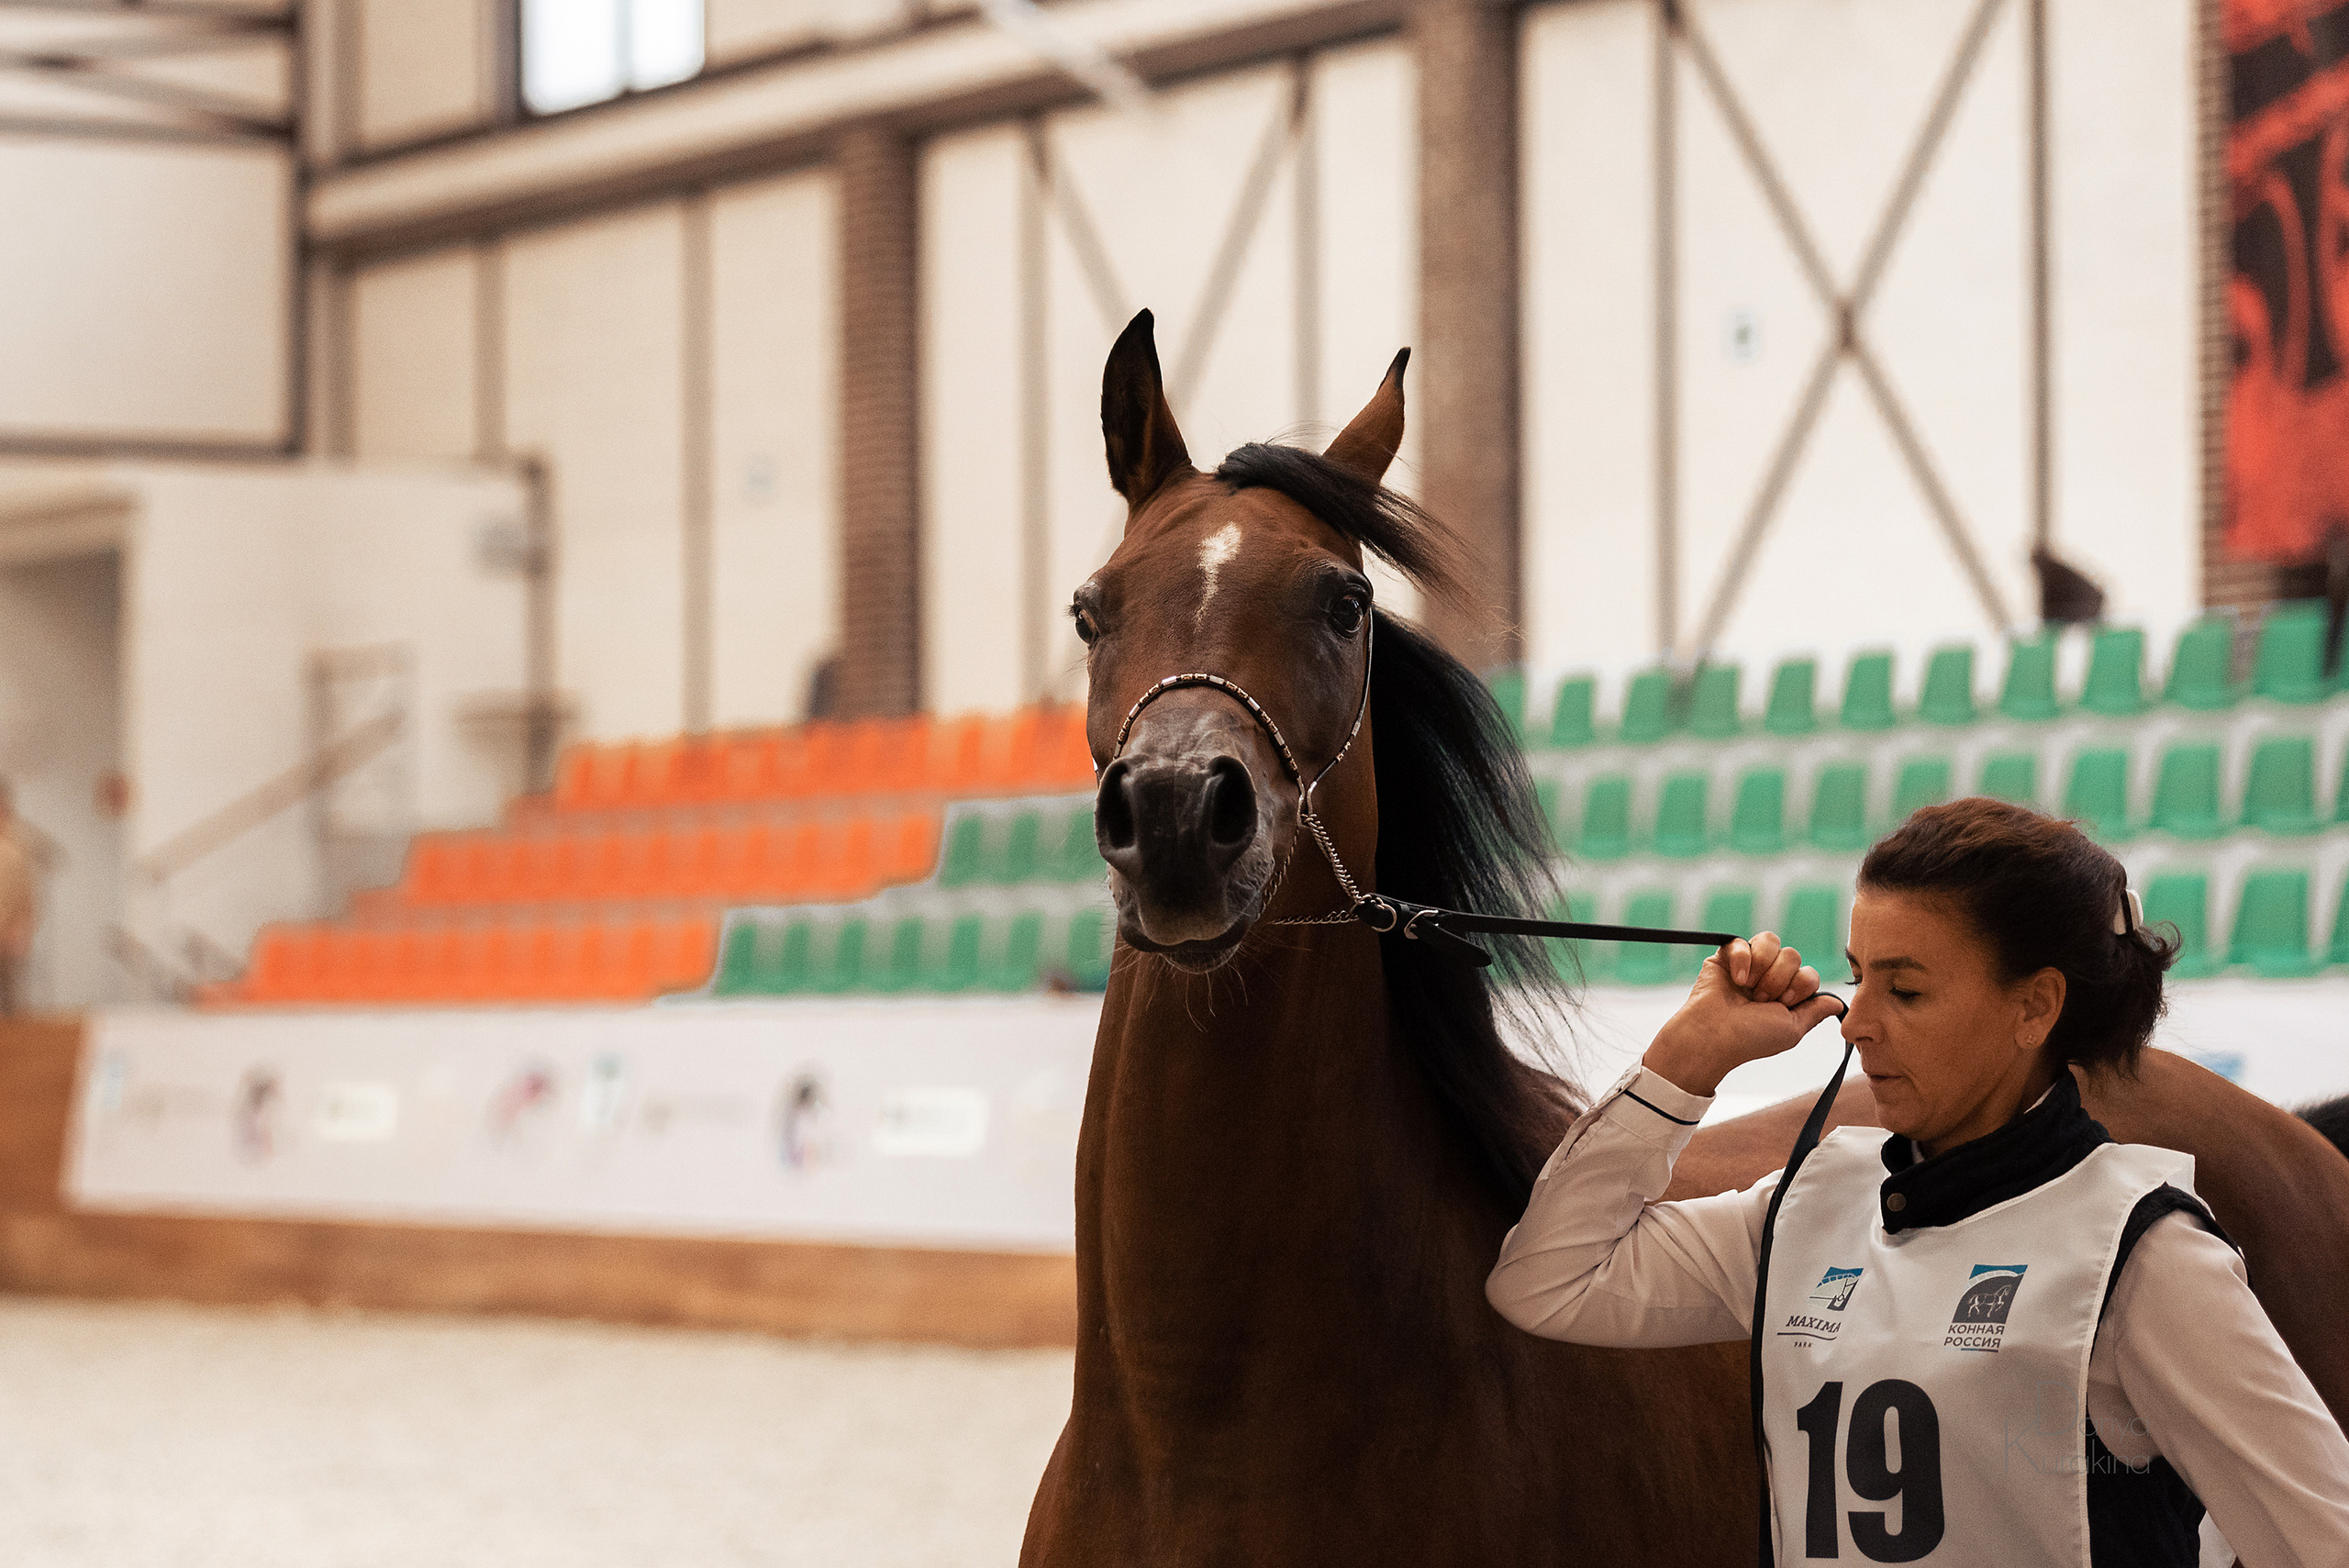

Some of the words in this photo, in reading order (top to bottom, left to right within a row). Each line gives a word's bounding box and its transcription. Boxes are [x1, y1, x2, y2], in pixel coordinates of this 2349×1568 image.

[1786, 1315, 1842, 1333] MAXIMA
[1948, 1324, 2005, 1335] КОННАЯ
[1943, 1336, 2001, 1348] РОССИЯ
[1797, 1379, 1945, 1563] 19
